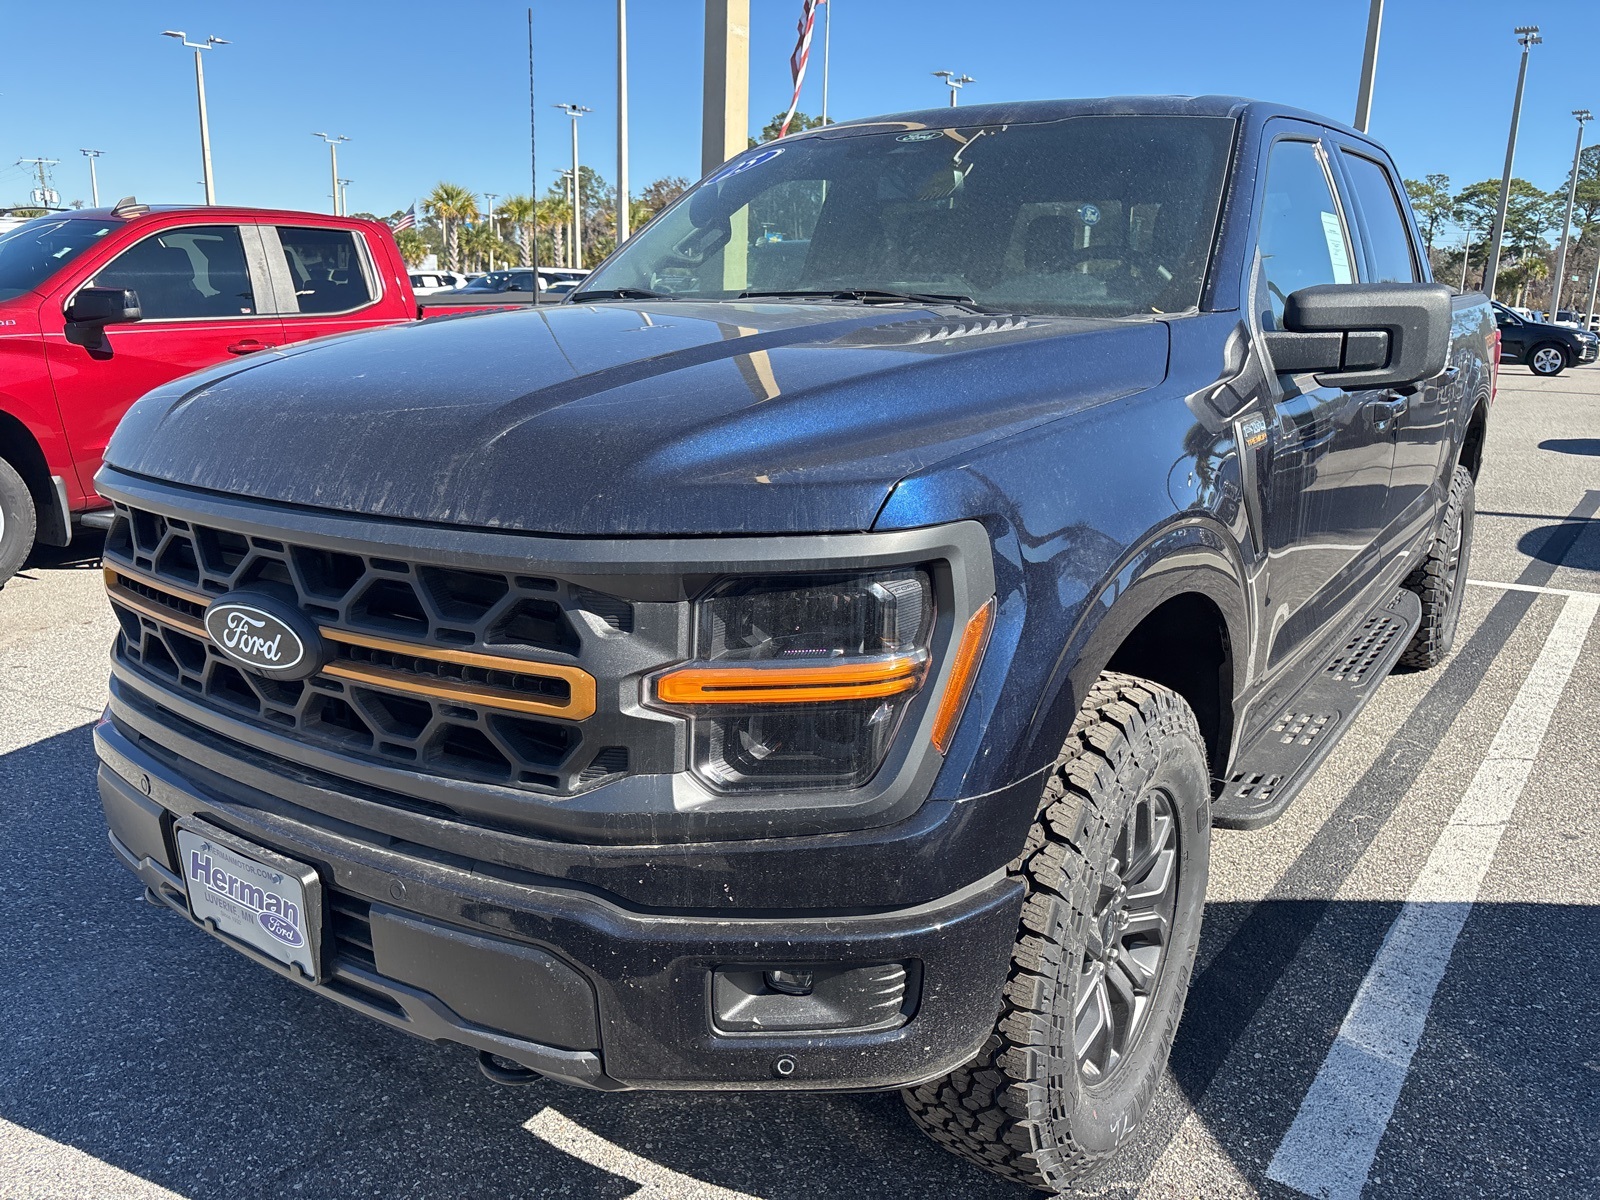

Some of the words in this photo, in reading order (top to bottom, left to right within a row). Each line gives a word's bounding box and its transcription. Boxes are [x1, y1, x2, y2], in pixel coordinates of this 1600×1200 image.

[895, 583, 920, 593] FORD
[223, 611, 282, 662] Ford
[190, 849, 300, 930] Herman
[241, 910, 254, 924] MN
[268, 916, 294, 941] Ford
